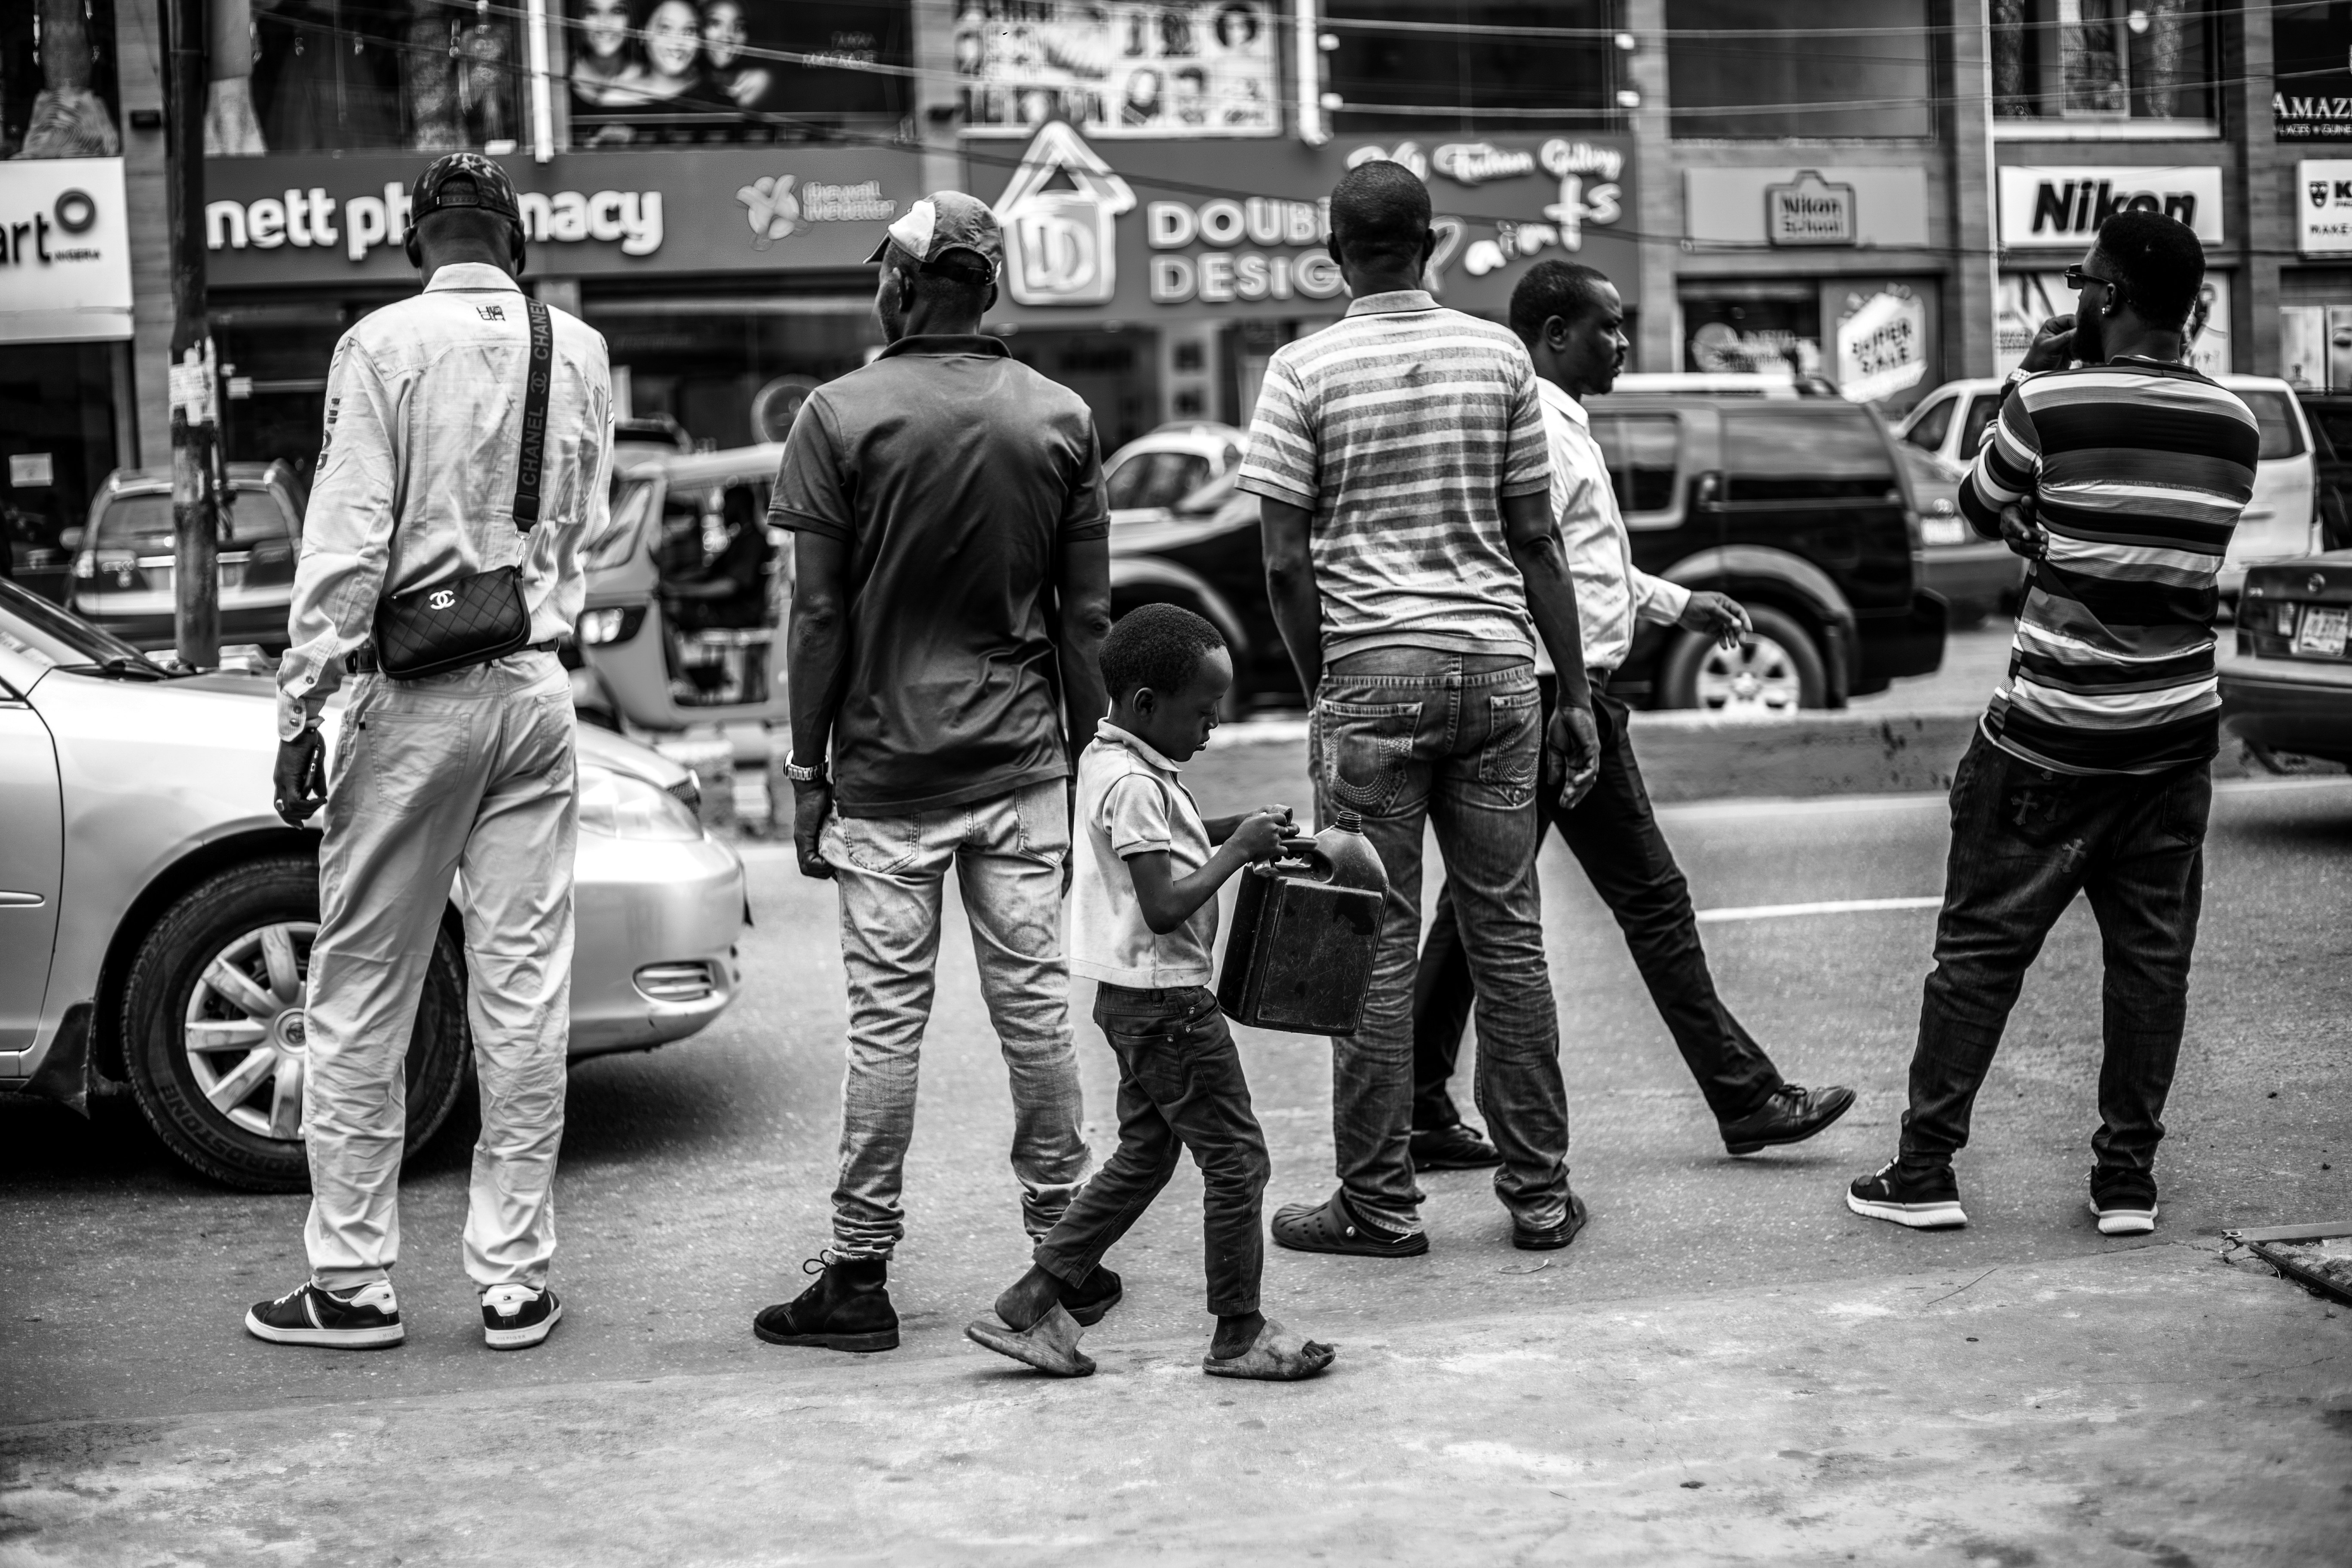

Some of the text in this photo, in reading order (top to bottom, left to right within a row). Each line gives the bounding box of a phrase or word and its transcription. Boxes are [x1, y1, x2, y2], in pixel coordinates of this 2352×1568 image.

[2271, 91, 2352, 119] AMAZ
[205, 181, 664, 260] nett phmacy
[1147, 196, 1332, 249] DOUB
[1150, 249, 1353, 304] DESIG
[529, 300, 549, 361] CHANEL
[521, 406, 545, 486] CHANEL
